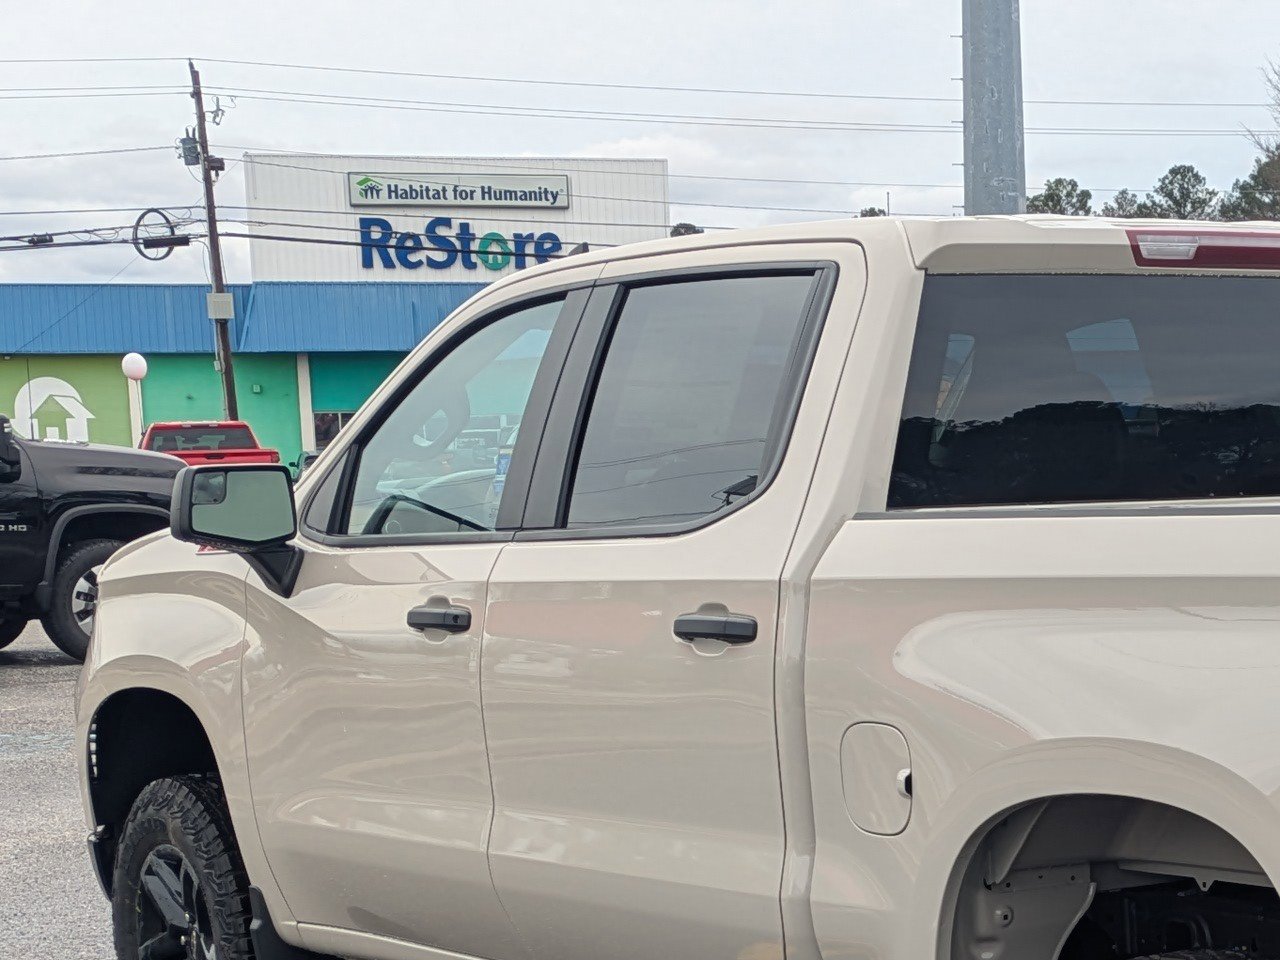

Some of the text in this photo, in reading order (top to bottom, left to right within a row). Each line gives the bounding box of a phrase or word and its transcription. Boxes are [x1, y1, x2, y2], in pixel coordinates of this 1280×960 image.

[387, 184, 448, 201] Habitat
[452, 184, 476, 201] for
[359, 217, 563, 271] ReStore
